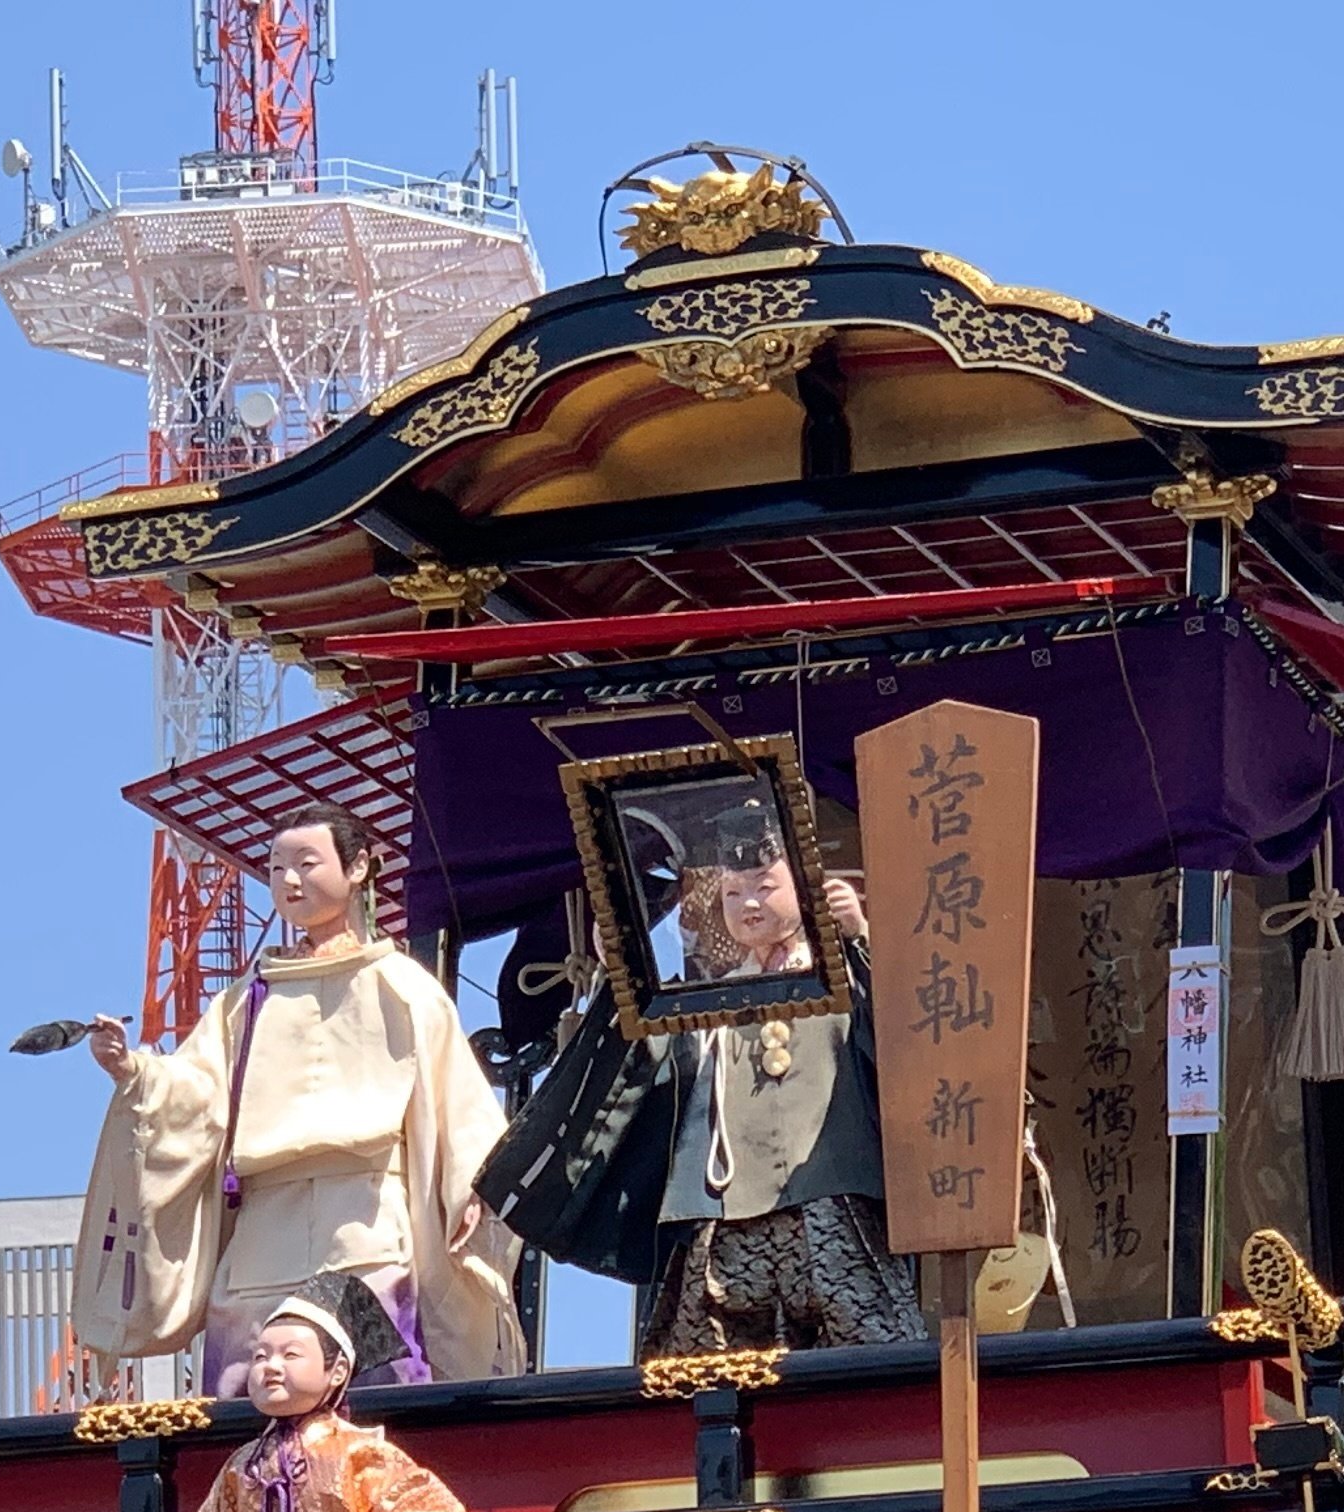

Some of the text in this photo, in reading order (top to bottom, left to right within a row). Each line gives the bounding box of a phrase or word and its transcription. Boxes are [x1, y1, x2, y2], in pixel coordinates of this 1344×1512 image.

[908, 734, 994, 1210] 菅原軕 新町
[1179, 961, 1209, 1088] 八幡神社
